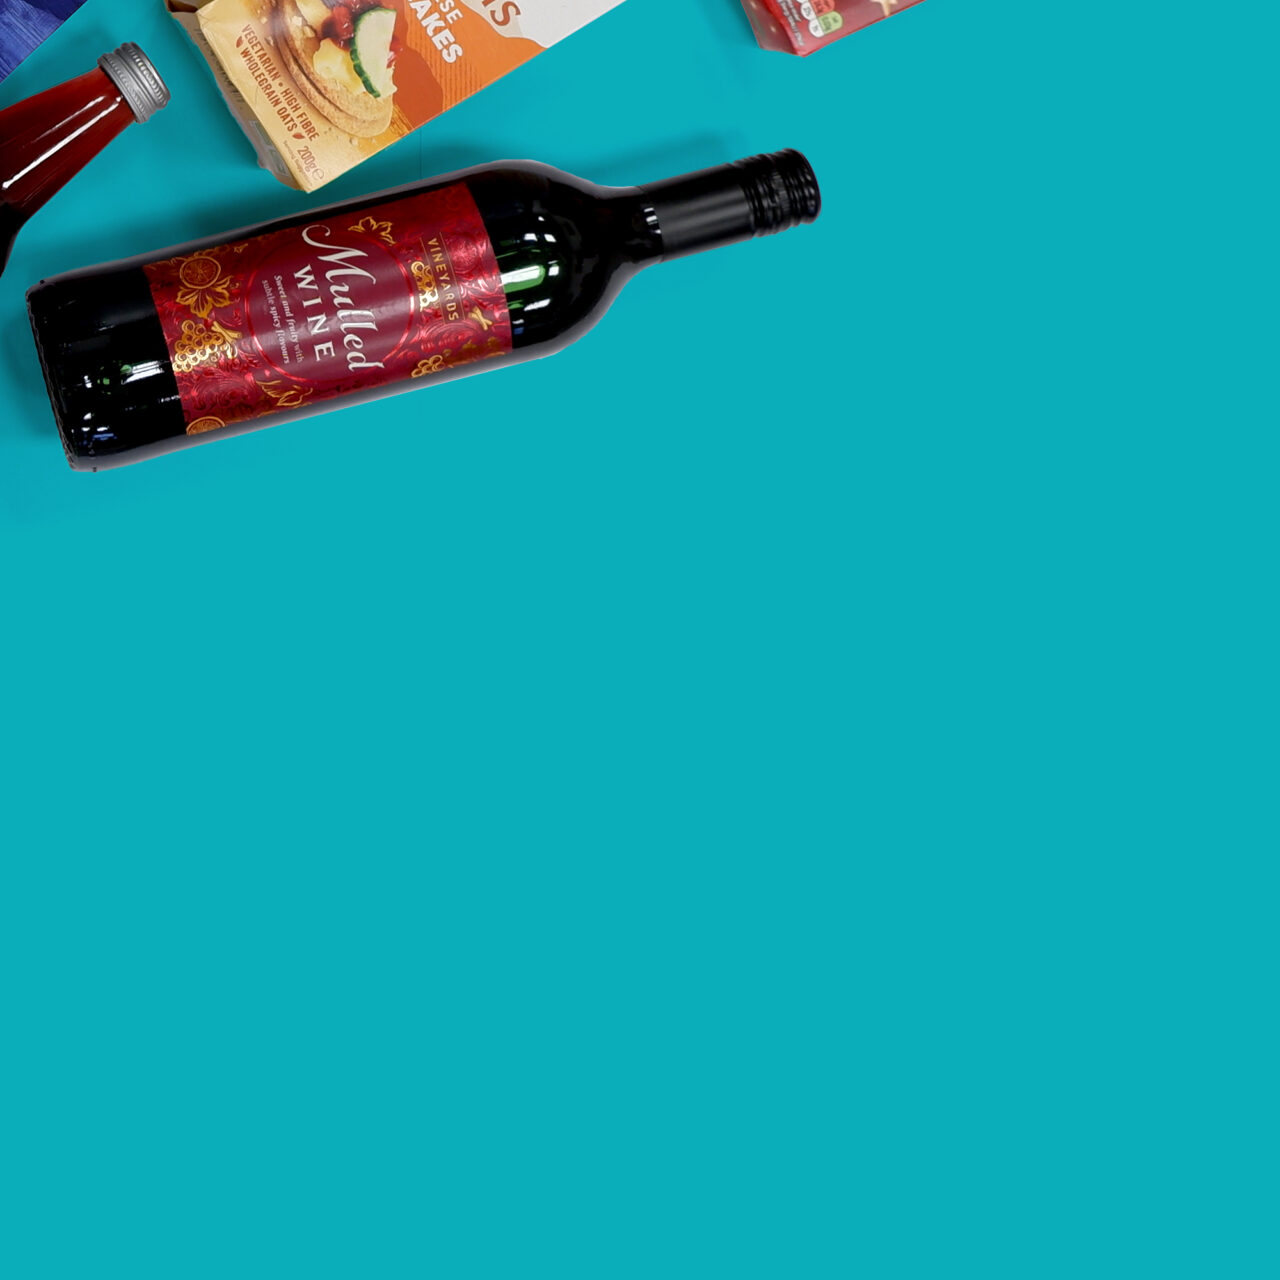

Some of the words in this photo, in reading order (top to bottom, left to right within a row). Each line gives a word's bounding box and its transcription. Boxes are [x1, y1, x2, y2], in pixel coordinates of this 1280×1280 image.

[239, 47, 282, 109] WHOLEGRAIN
[276, 107, 298, 132] OATS
[241, 24, 281, 86] VEGETARIAN
[280, 87, 302, 112] HIGH
[296, 110, 320, 142] FIBRE
[262, 279, 275, 306] subtle
[274, 275, 287, 300] Sweet
[426, 237, 460, 322] VINEYARDS
[282, 299, 294, 318] and
[293, 264, 336, 362] WINE
[301, 224, 386, 372] Mulled
[270, 305, 282, 330] spicy
[286, 317, 299, 344] fruity
[275, 329, 291, 365] flavours
[293, 343, 305, 364] with
